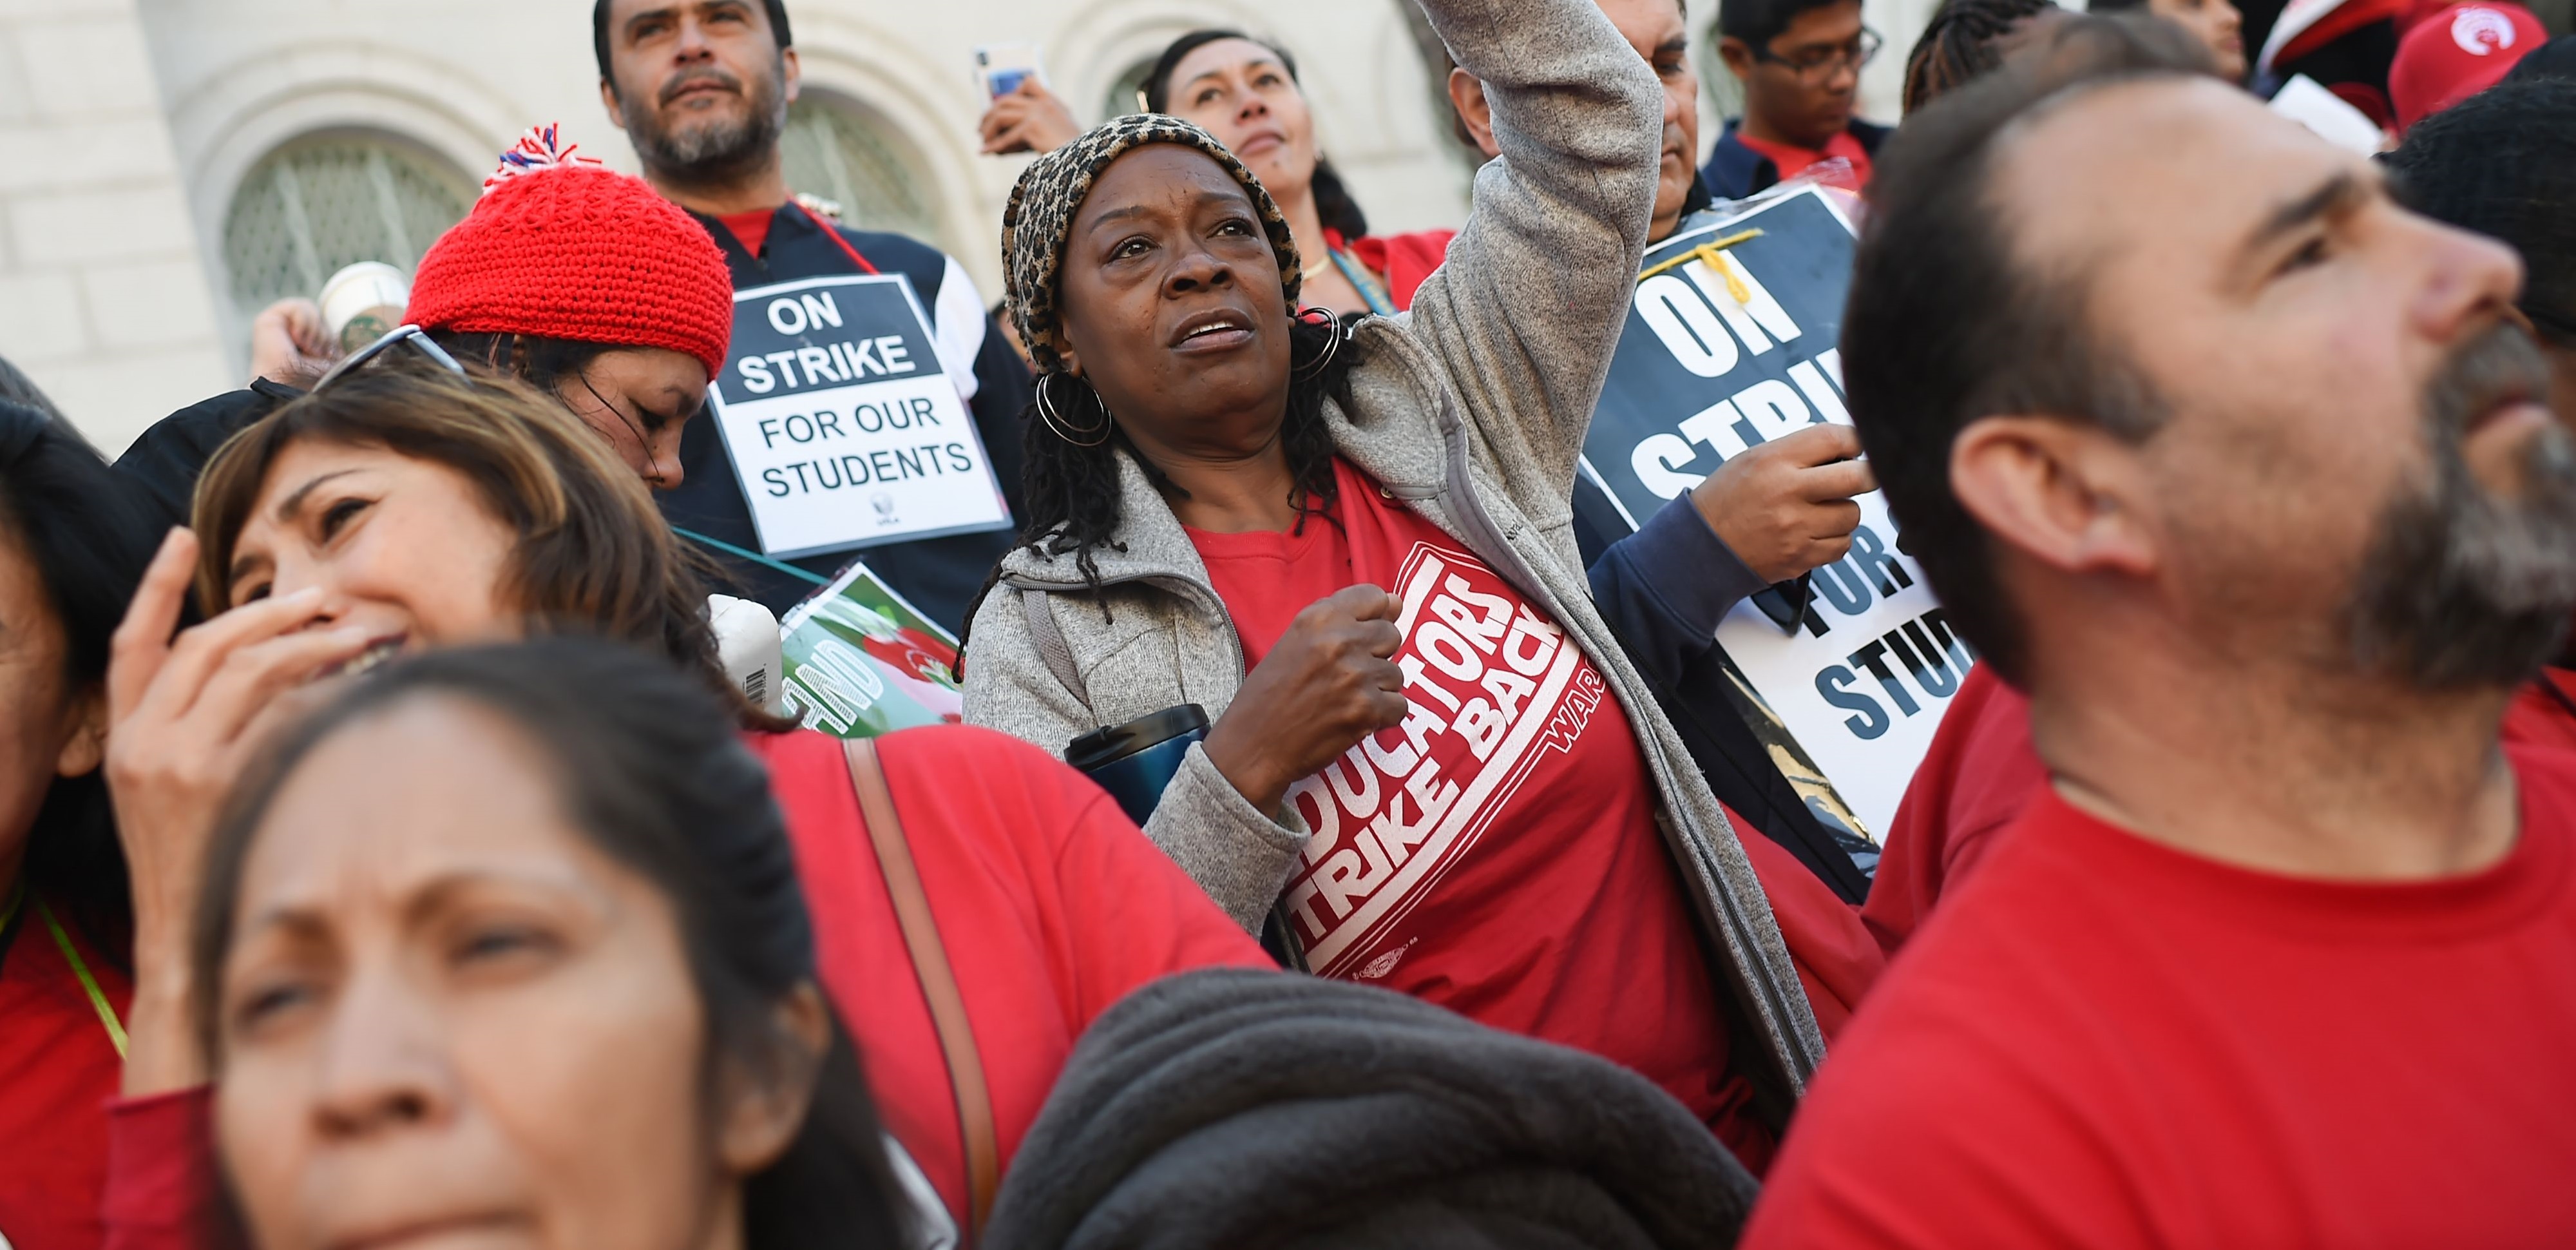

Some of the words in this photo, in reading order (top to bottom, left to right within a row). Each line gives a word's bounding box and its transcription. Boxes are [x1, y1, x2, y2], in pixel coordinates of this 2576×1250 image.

[768, 292, 843, 335] ON
[1634, 249, 1802, 378] ON
[738, 335, 915, 394] STRIKE
[759, 410, 845, 448] FOR
[855, 398, 940, 434] OUR
[763, 443, 971, 497] STUDENTS
[1284, 572, 1513, 884] DUCATORS
[1546, 655, 1606, 753] WAR
[1286, 756, 1460, 952] TRIKE
[1451, 602, 1563, 764] BACK
